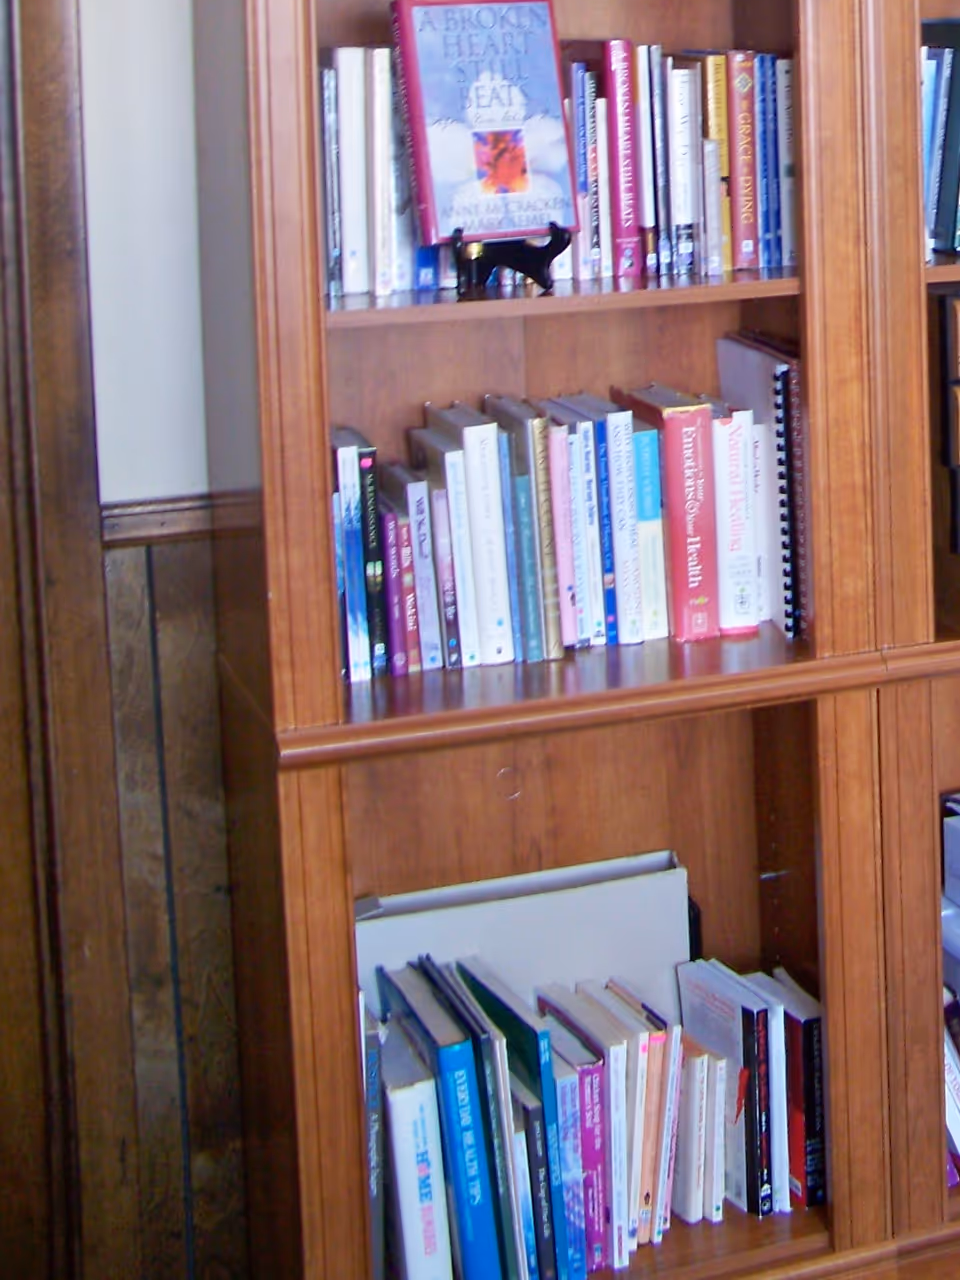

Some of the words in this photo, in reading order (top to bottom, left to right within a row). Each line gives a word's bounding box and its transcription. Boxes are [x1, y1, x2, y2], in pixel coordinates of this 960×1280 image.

[418, 12, 437, 33] A
[444, 4, 549, 33] BROKEN
[444, 30, 528, 60] HEART
[457, 56, 530, 83] STILL
[459, 82, 530, 113] BEATS
[738, 112, 752, 161] GRACE
[624, 192, 634, 228] BEATS
[740, 176, 754, 224] DYING
[681, 426, 700, 500] Emotions
[727, 423, 747, 482] Natural
[727, 488, 747, 554] Healing
[686, 536, 704, 589] Health
[454, 1070, 474, 1127] EVERYDAY
[416, 1150, 433, 1203] HOME
[461, 1130, 477, 1176] HEALTH
[468, 1180, 483, 1206] TIPS
